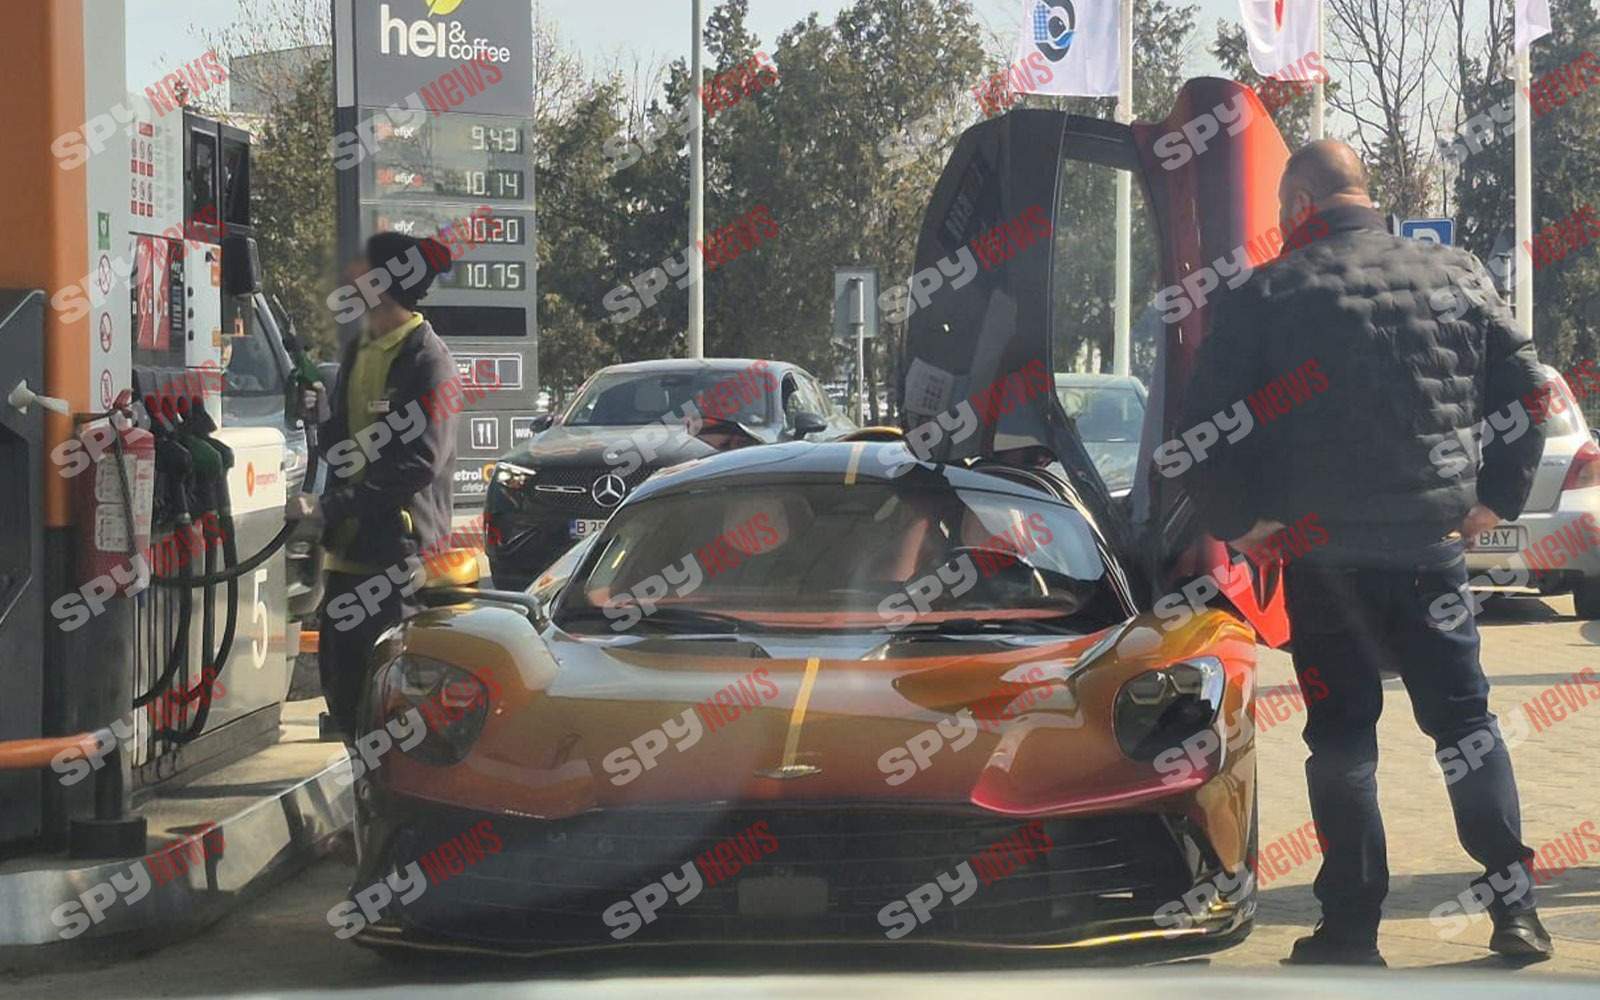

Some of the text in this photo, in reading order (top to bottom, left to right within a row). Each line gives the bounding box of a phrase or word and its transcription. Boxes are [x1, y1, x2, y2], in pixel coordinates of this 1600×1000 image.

[380, 4, 467, 58] hei &
[448, 38, 511, 63] coffee
[471, 126, 517, 151] 9.43
[466, 171, 518, 197] 10.14
[467, 216, 519, 243] 10.20
[466, 263, 520, 289] 10.75
[576, 521, 586, 534] B
[1479, 532, 1511, 545] BAY
[252, 568, 268, 669] 5
